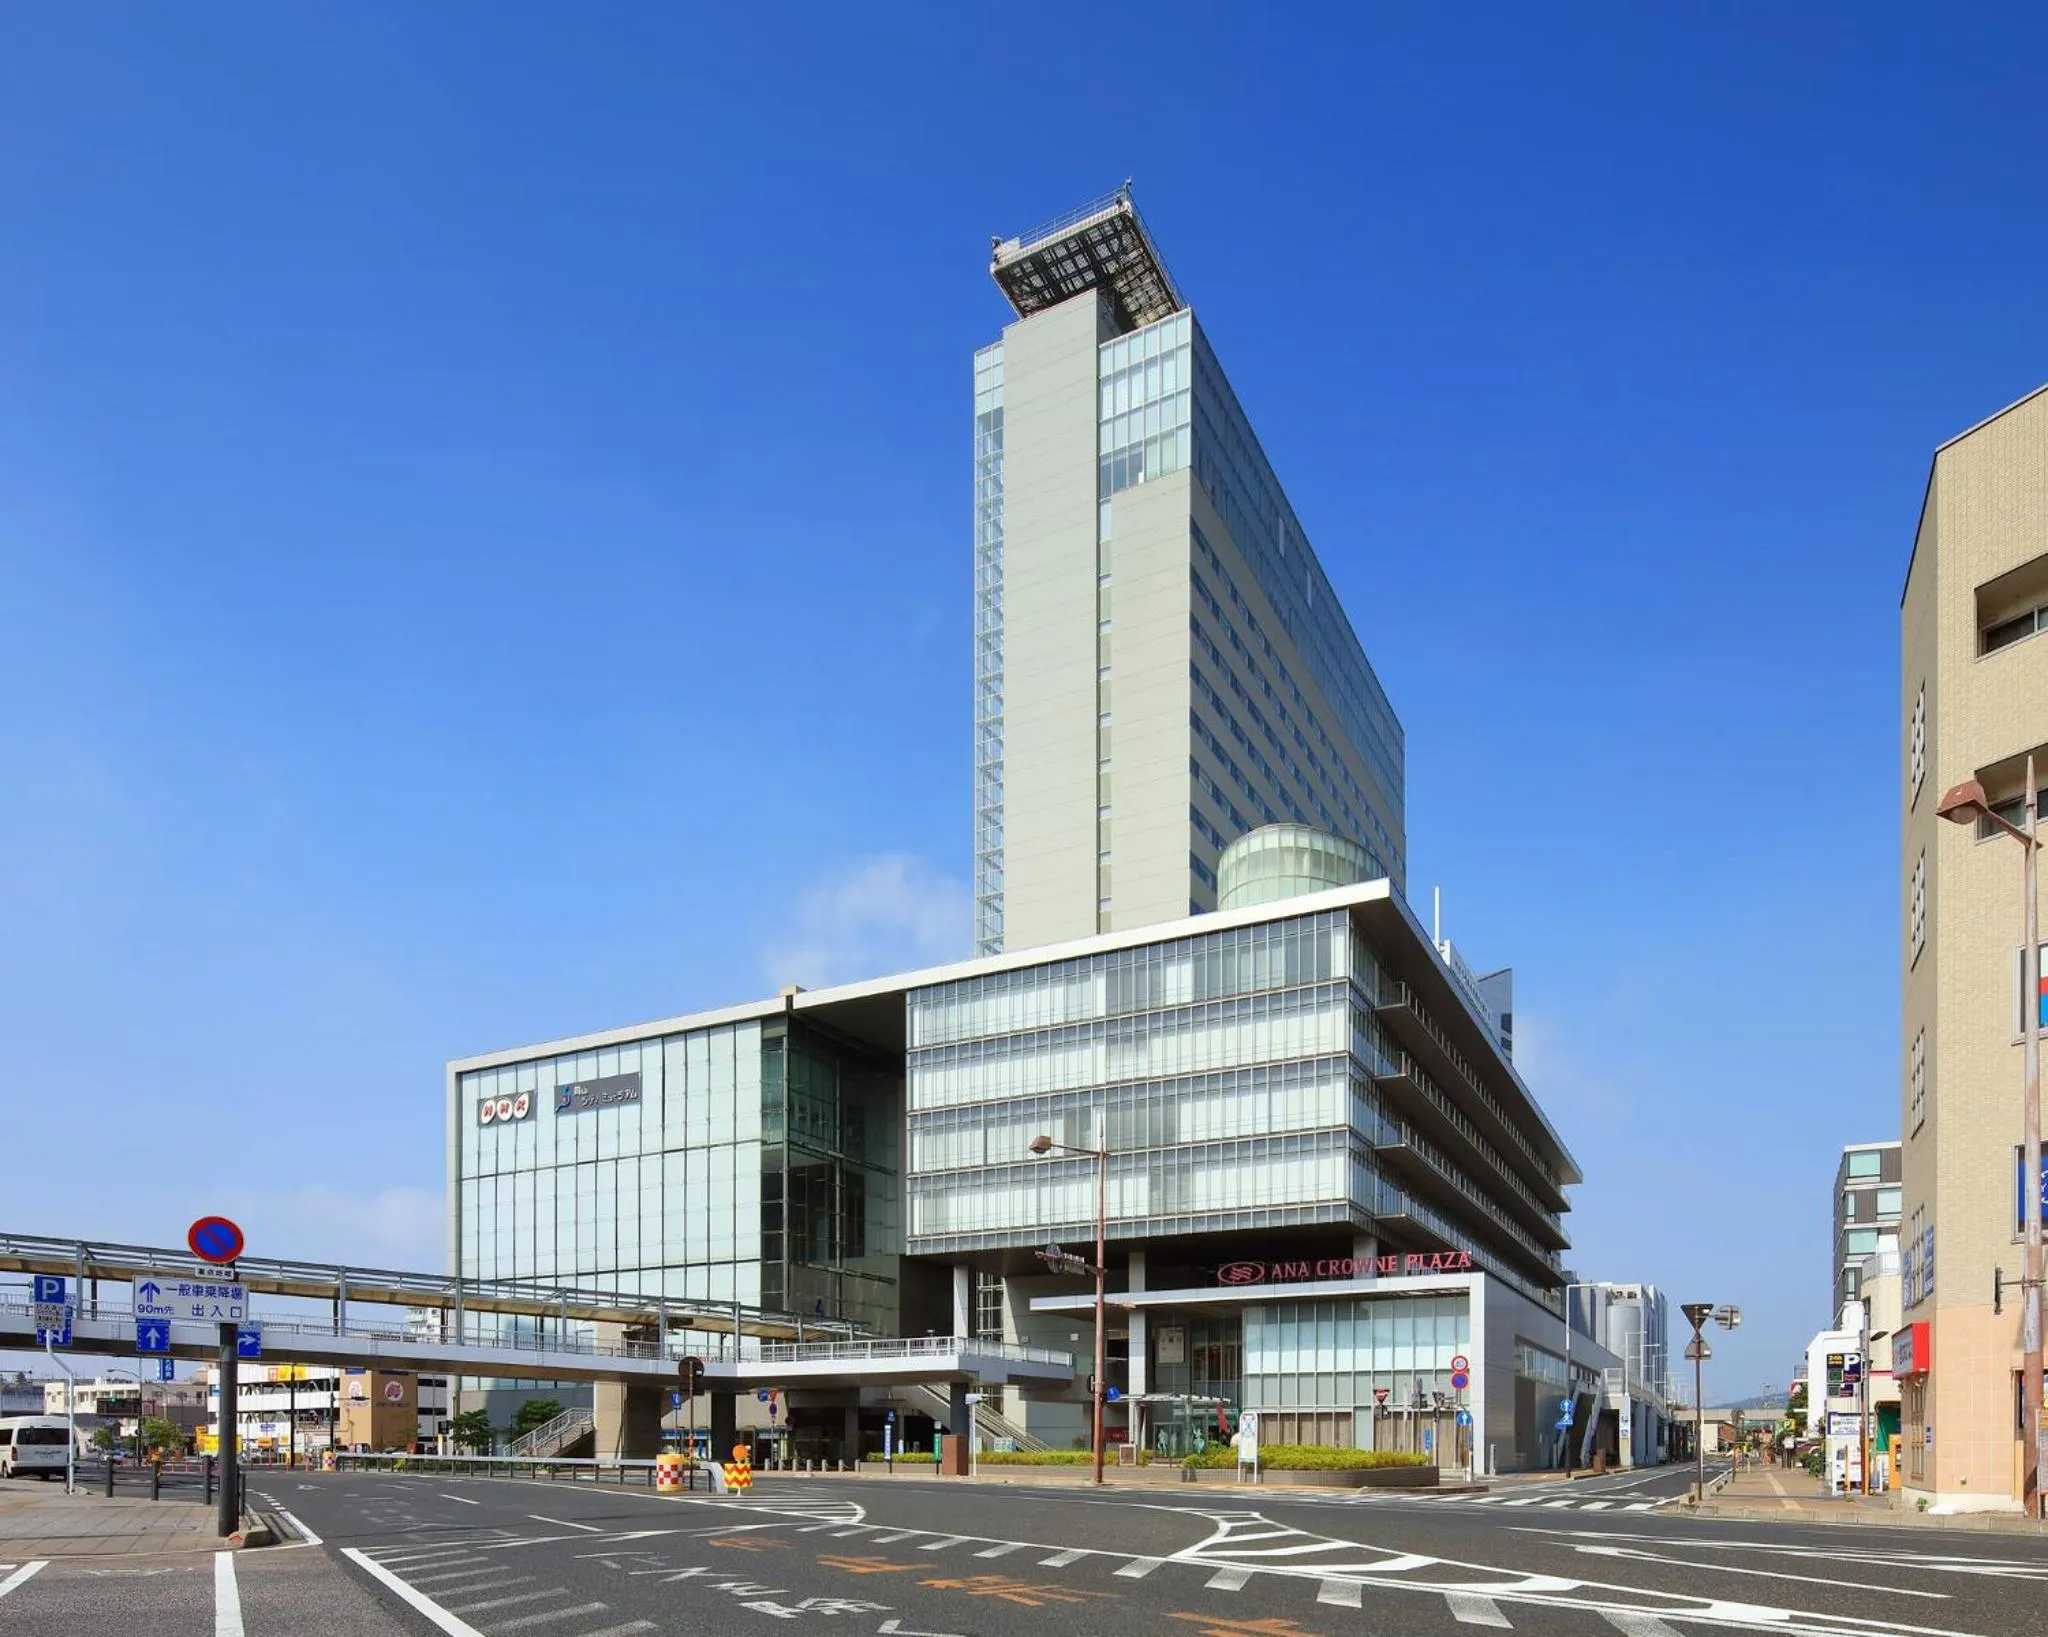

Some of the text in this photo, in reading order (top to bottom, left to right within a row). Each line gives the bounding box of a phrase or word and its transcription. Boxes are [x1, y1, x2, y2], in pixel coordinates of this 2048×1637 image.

[1271, 1251, 1472, 1279] ANA CROWNE PLAZA
[41, 1278, 60, 1300] P
[191, 1304, 243, 1318] 出入口
[1844, 1354, 1860, 1371] P
